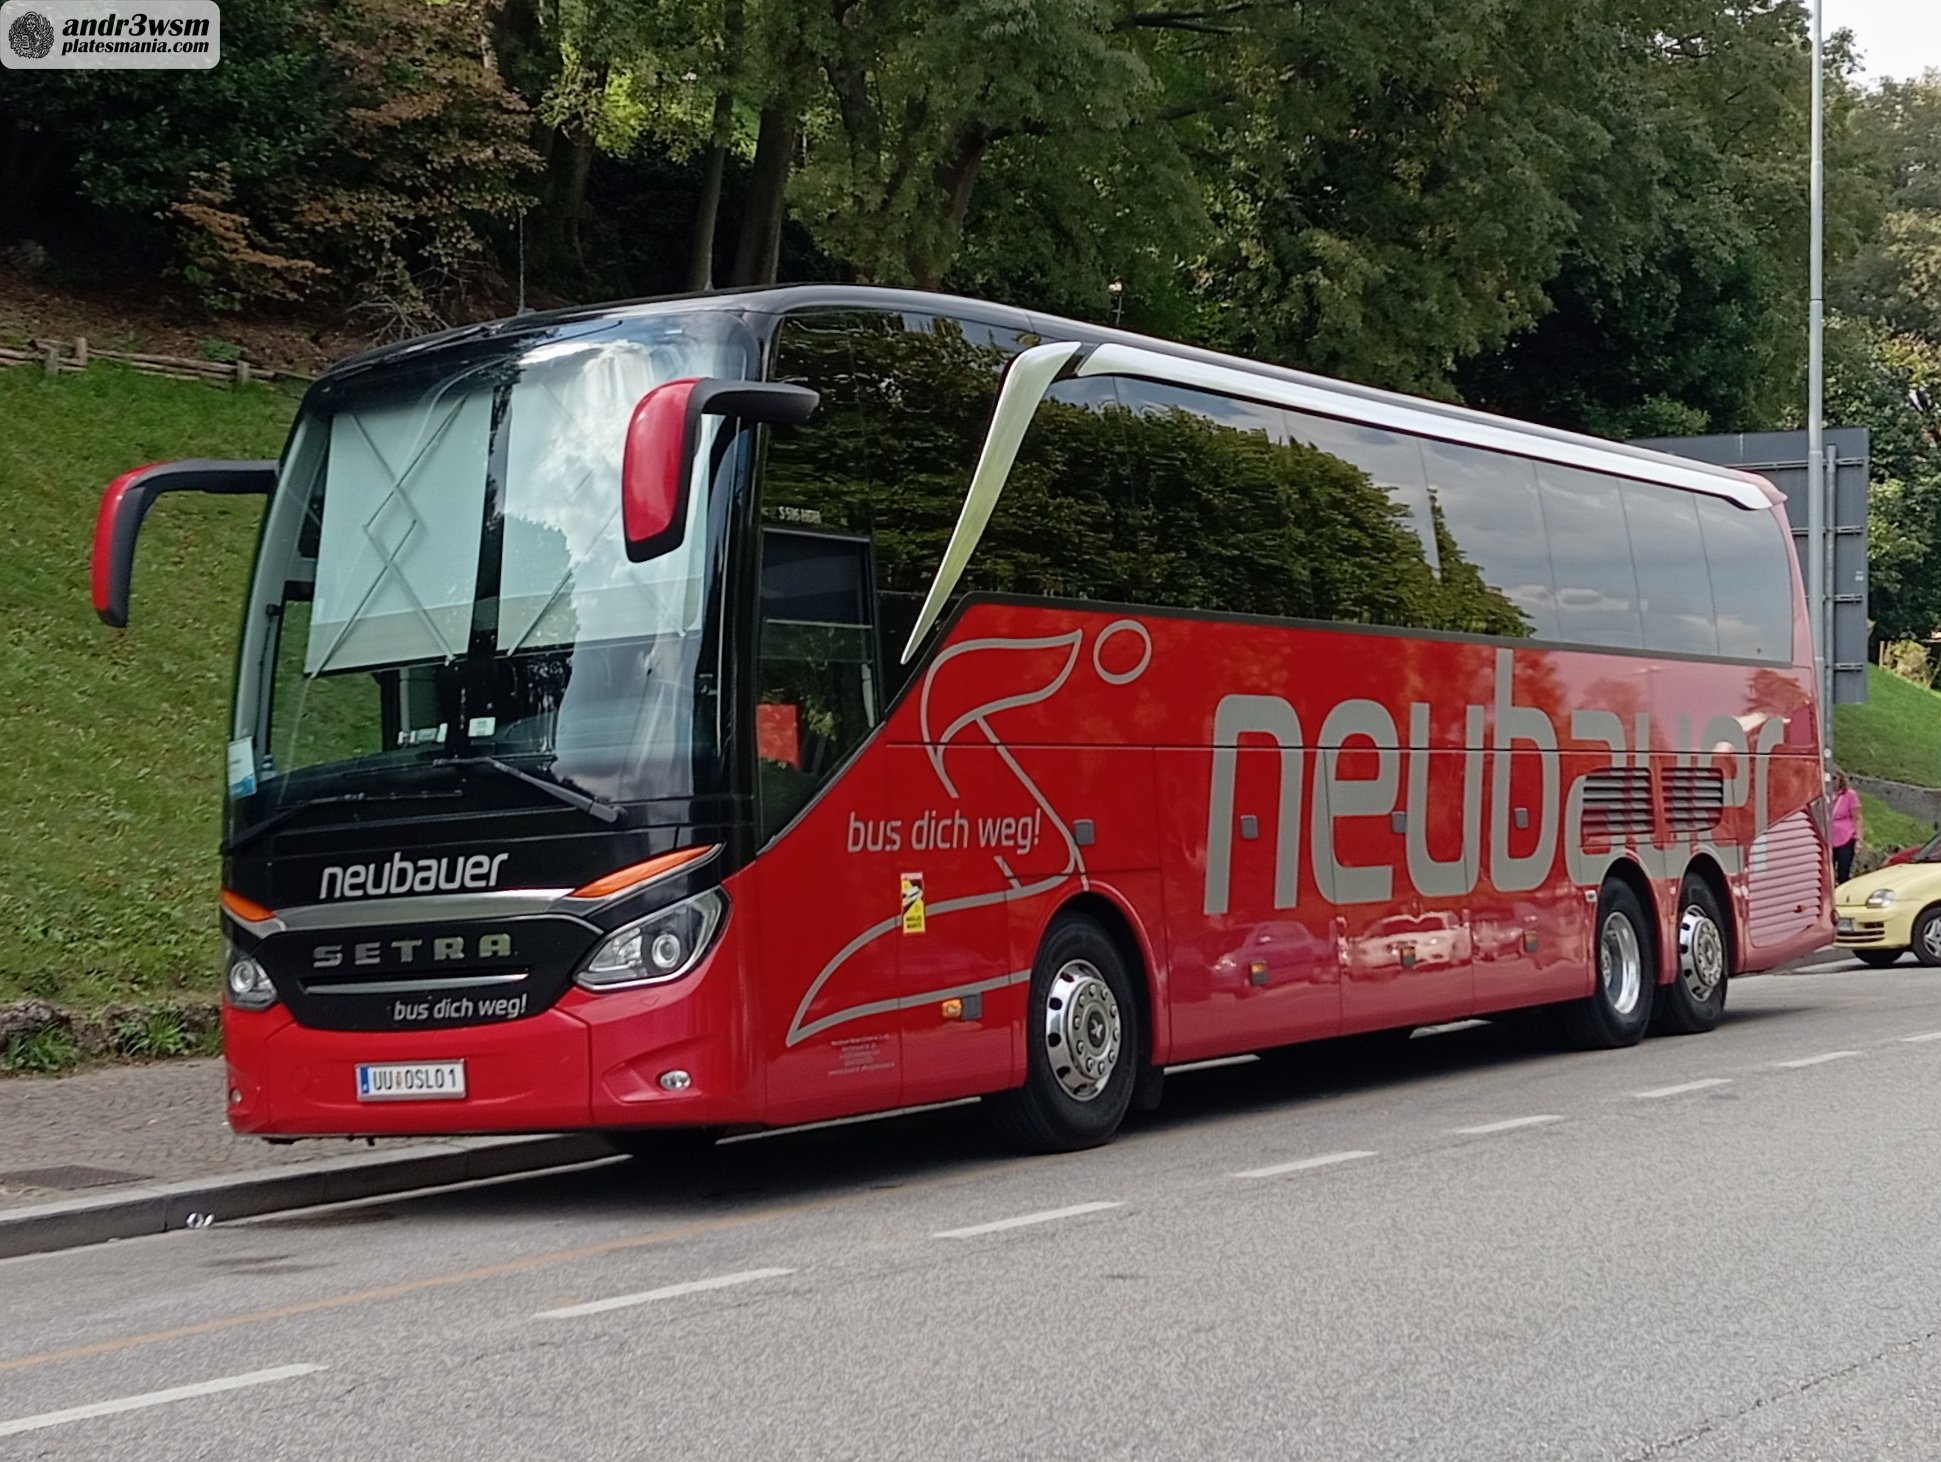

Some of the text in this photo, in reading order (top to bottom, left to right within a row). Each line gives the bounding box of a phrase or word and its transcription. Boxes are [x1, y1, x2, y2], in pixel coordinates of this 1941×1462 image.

[1203, 648, 1784, 915] neubauer
[847, 808, 1042, 855] bus dich weg!
[319, 851, 509, 899] neubauer
[312, 933, 512, 968] SETRA
[393, 993, 528, 1021] bus dich weg!
